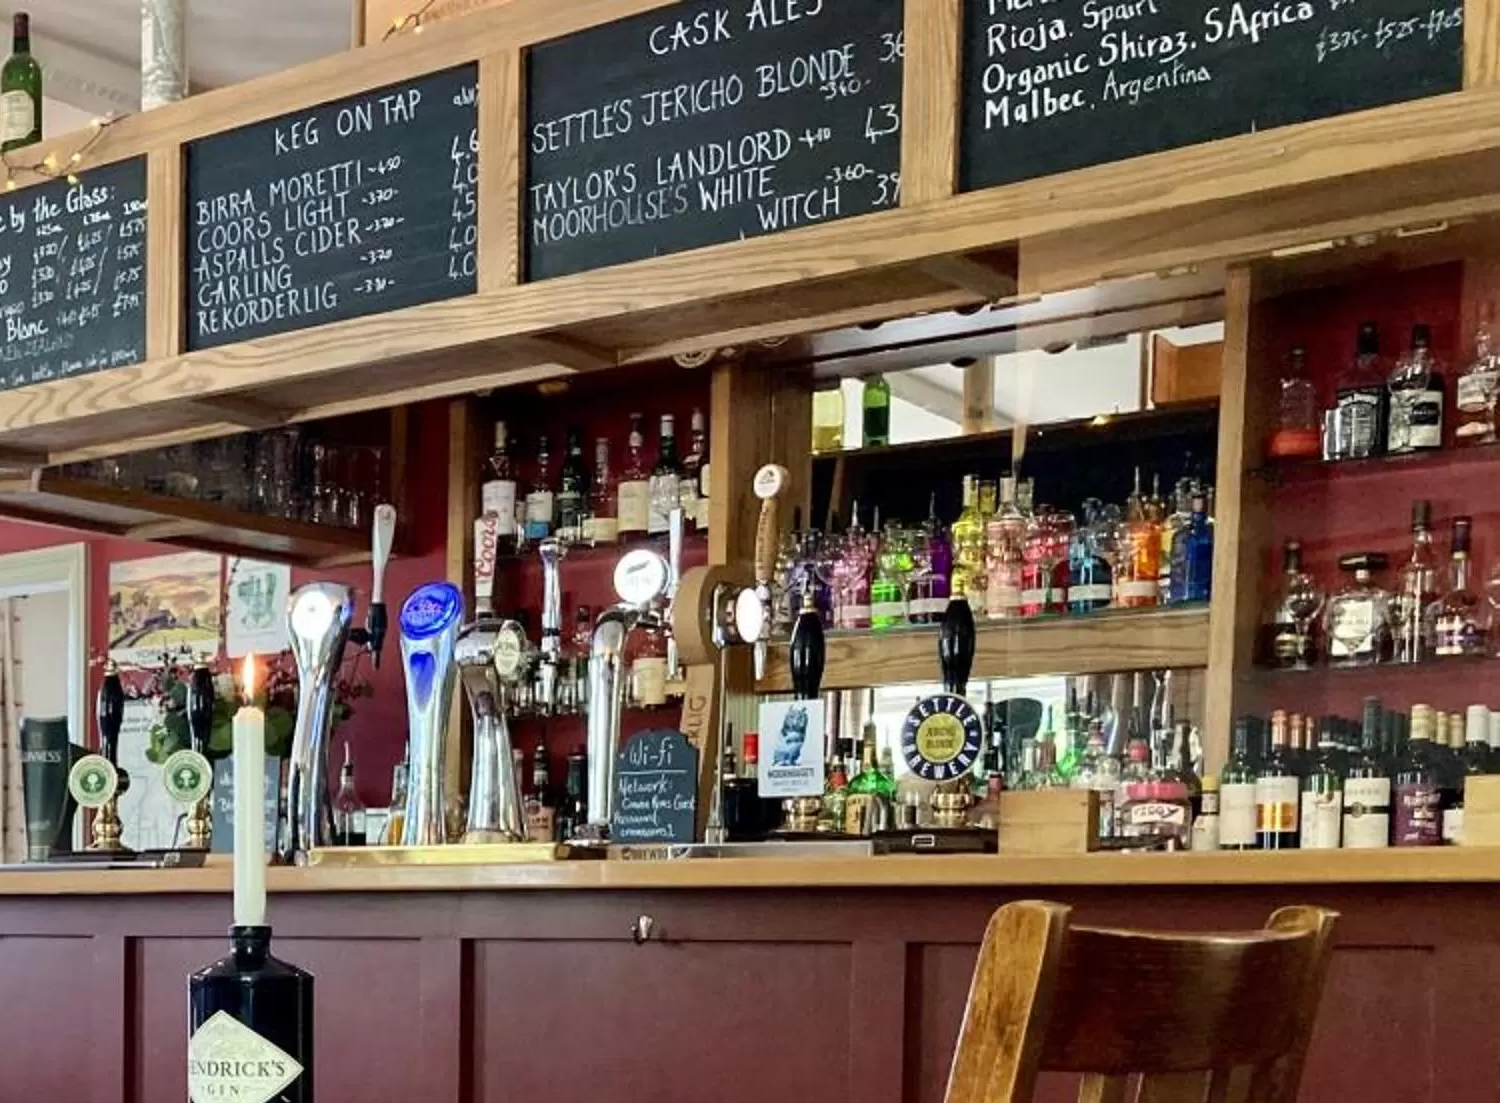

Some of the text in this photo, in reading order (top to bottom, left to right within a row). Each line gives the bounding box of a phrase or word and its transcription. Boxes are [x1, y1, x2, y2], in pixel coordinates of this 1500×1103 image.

[650, 9, 731, 55] CASK
[982, 52, 1090, 95] Organic
[1103, 60, 1212, 105] Argentina
[532, 99, 633, 154] SETTLE'S
[641, 74, 743, 127] JERICHO
[756, 43, 855, 98] BLONDE
[276, 118, 320, 155] KEG
[337, 103, 373, 137] ON
[380, 89, 421, 125] TAP
[196, 188, 255, 226] BIRRA
[269, 160, 361, 206] MORETTI
[530, 162, 636, 213] TAYLOR'S
[657, 128, 792, 186] LANDLORD
[10, 204, 25, 232] by
[32, 196, 62, 222] the
[197, 212, 271, 253] COORS
[285, 192, 349, 232] LIGHT
[532, 184, 688, 247] MOORHOUSE'S
[698, 165, 776, 212] WHITE
[757, 186, 840, 231] WITCH
[194, 237, 284, 284] ASPALLS
[295, 218, 362, 256] CIDER
[198, 264, 293, 307] CARLING
[6, 315, 49, 342] Blanc
[197, 282, 338, 336] REKORDERLIG
[907, 697, 977, 727] SETTLE
[190, 1060, 286, 1078] ENDRICK'S
[207, 1085, 241, 1096] GIN
